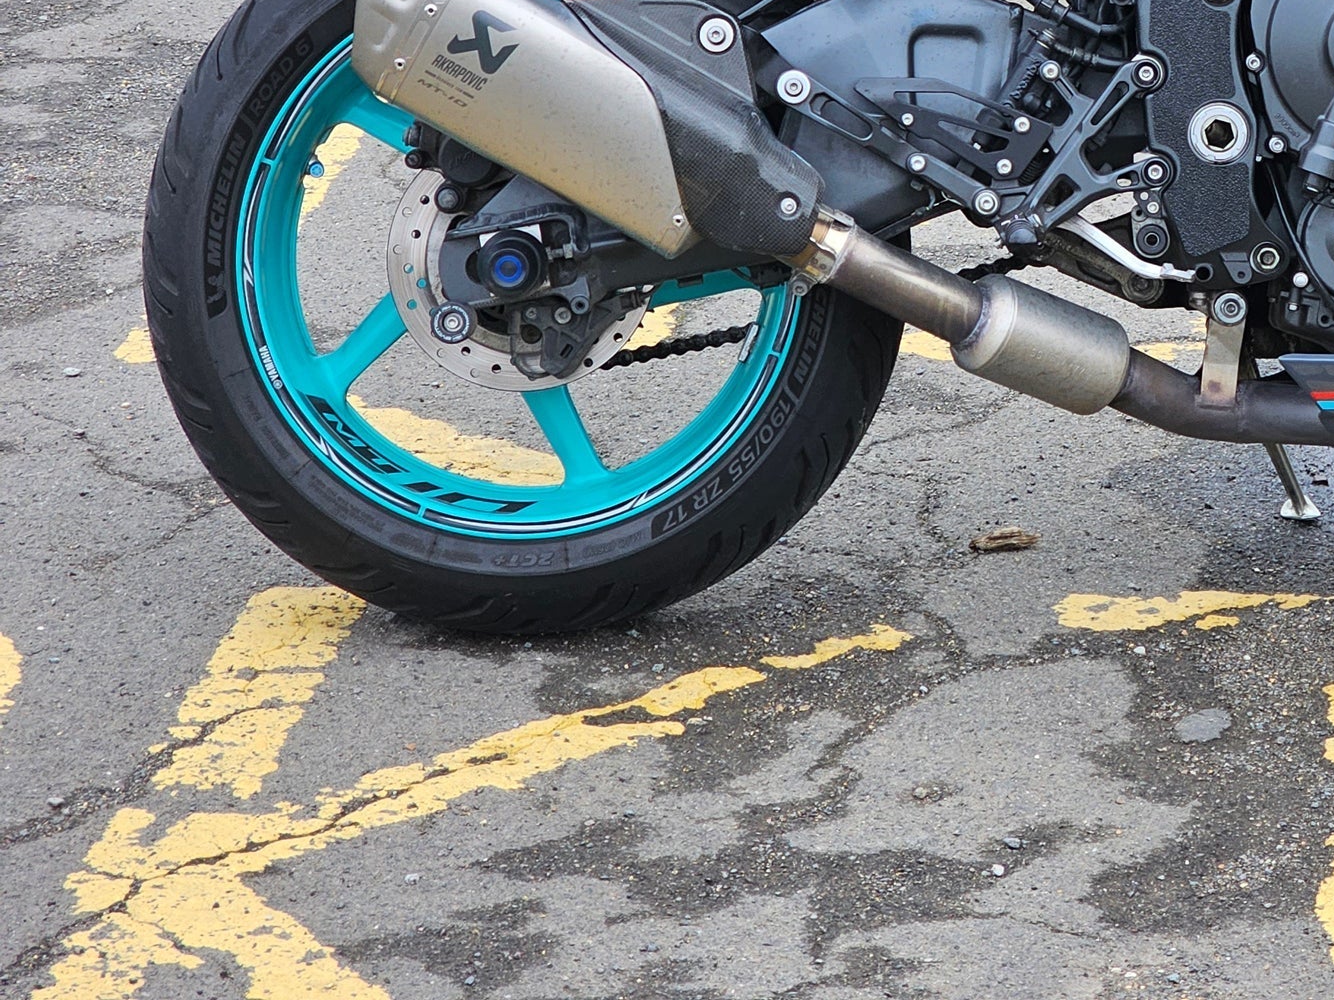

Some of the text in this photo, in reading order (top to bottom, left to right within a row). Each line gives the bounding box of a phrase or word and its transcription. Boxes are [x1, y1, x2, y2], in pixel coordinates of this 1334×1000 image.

[251, 57, 294, 115] ROAD
[417, 78, 468, 108] MT-10
[206, 133, 248, 268] MICHELIN
[259, 345, 279, 382] YAMAHA
[662, 399, 792, 532] 190/55 ZR 17
